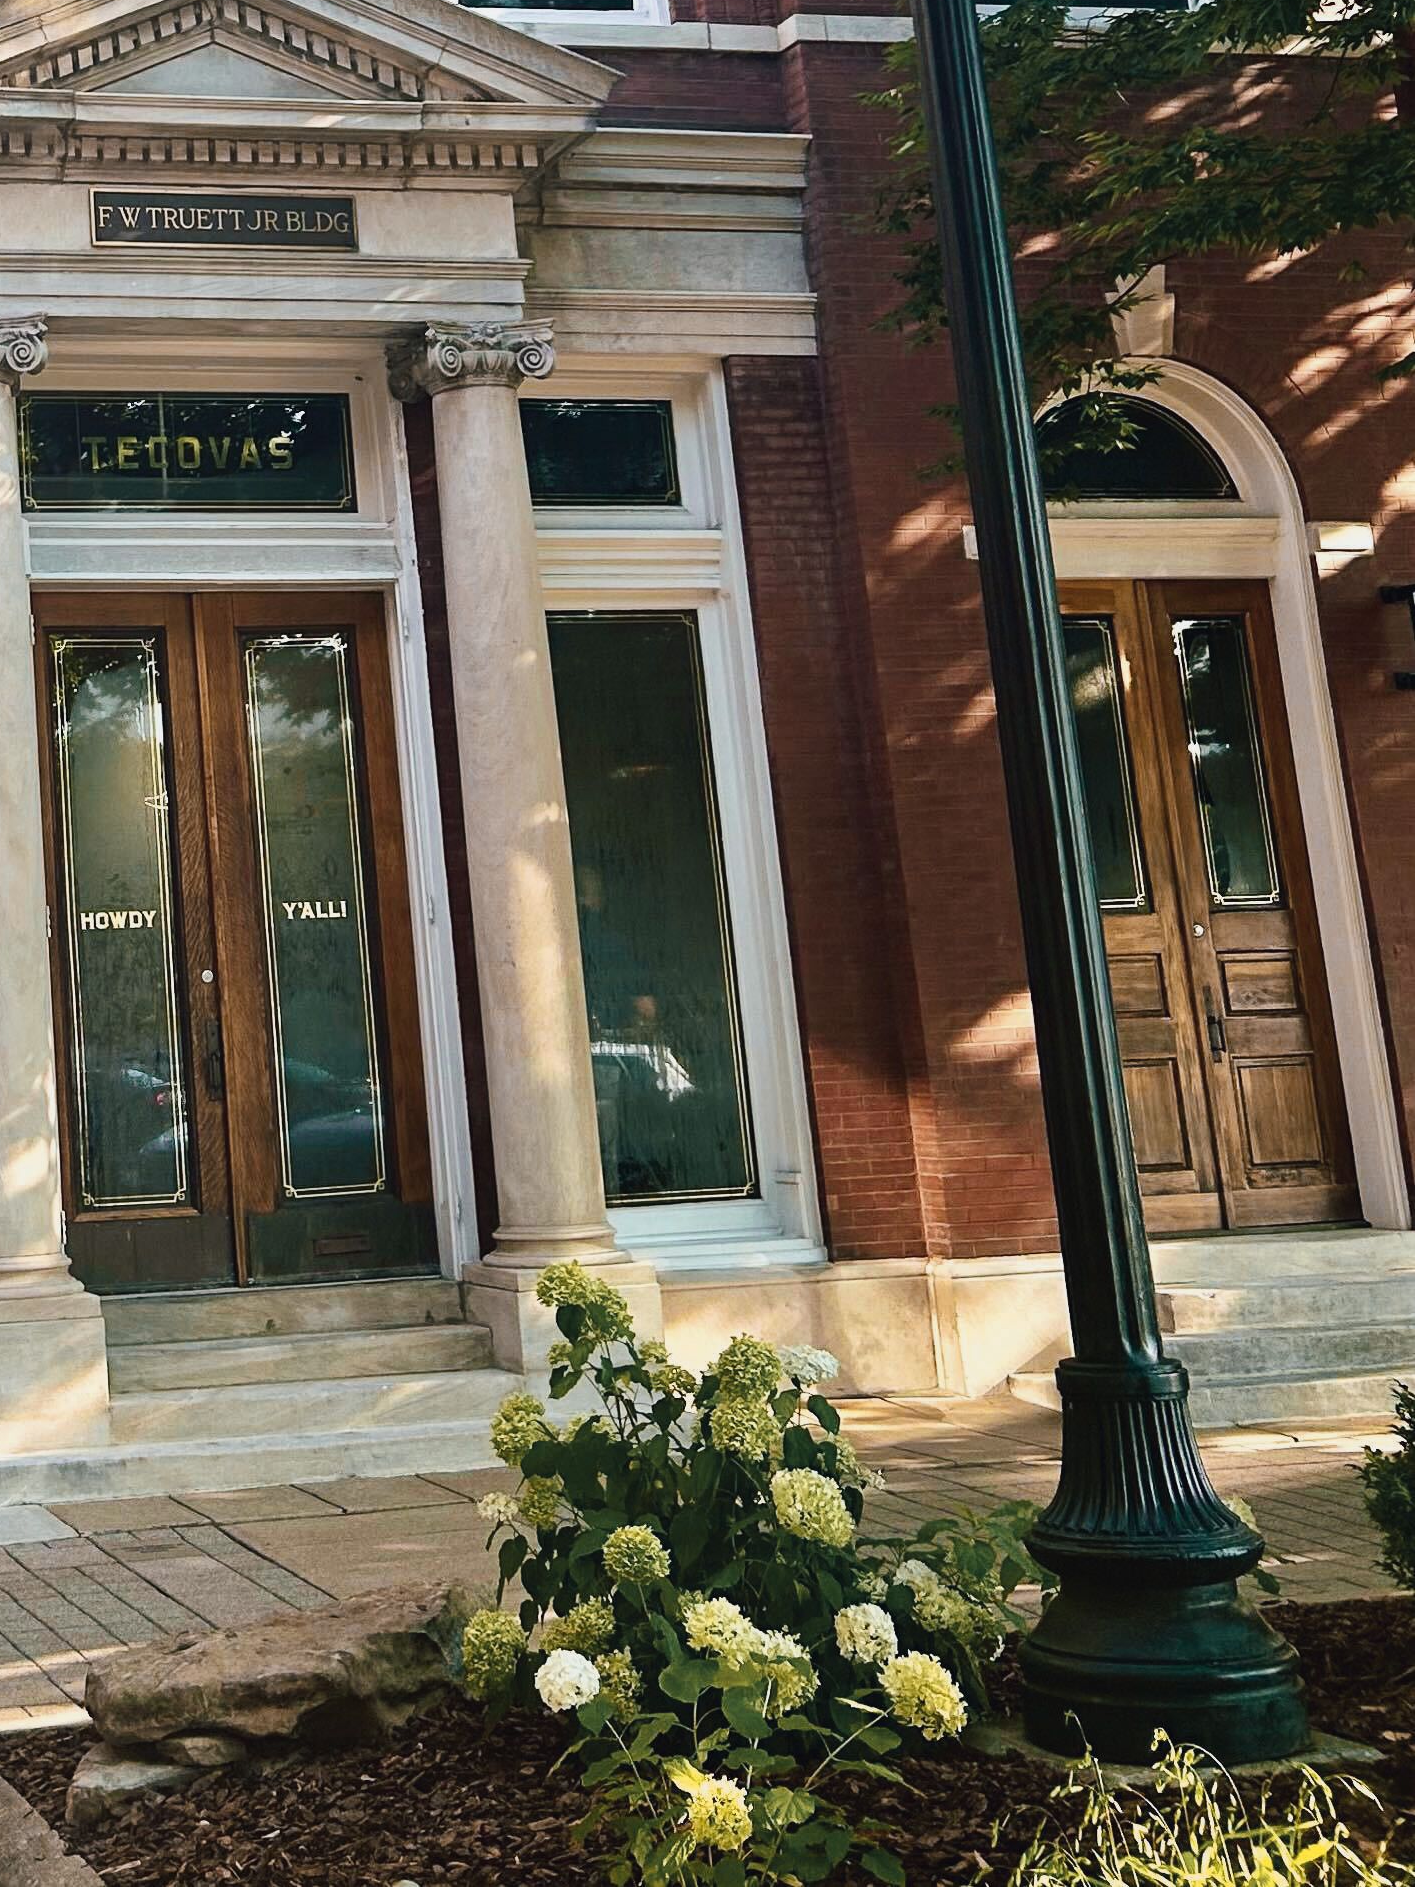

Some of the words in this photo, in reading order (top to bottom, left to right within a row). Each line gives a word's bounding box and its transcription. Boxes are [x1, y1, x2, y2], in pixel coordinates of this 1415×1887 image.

[145, 207, 245, 232] TRUETT
[285, 210, 350, 233] BLDG
[82, 436, 295, 471] TECOVAS
[81, 910, 157, 931] HOWDY
[282, 900, 348, 920] Y'ALL!
